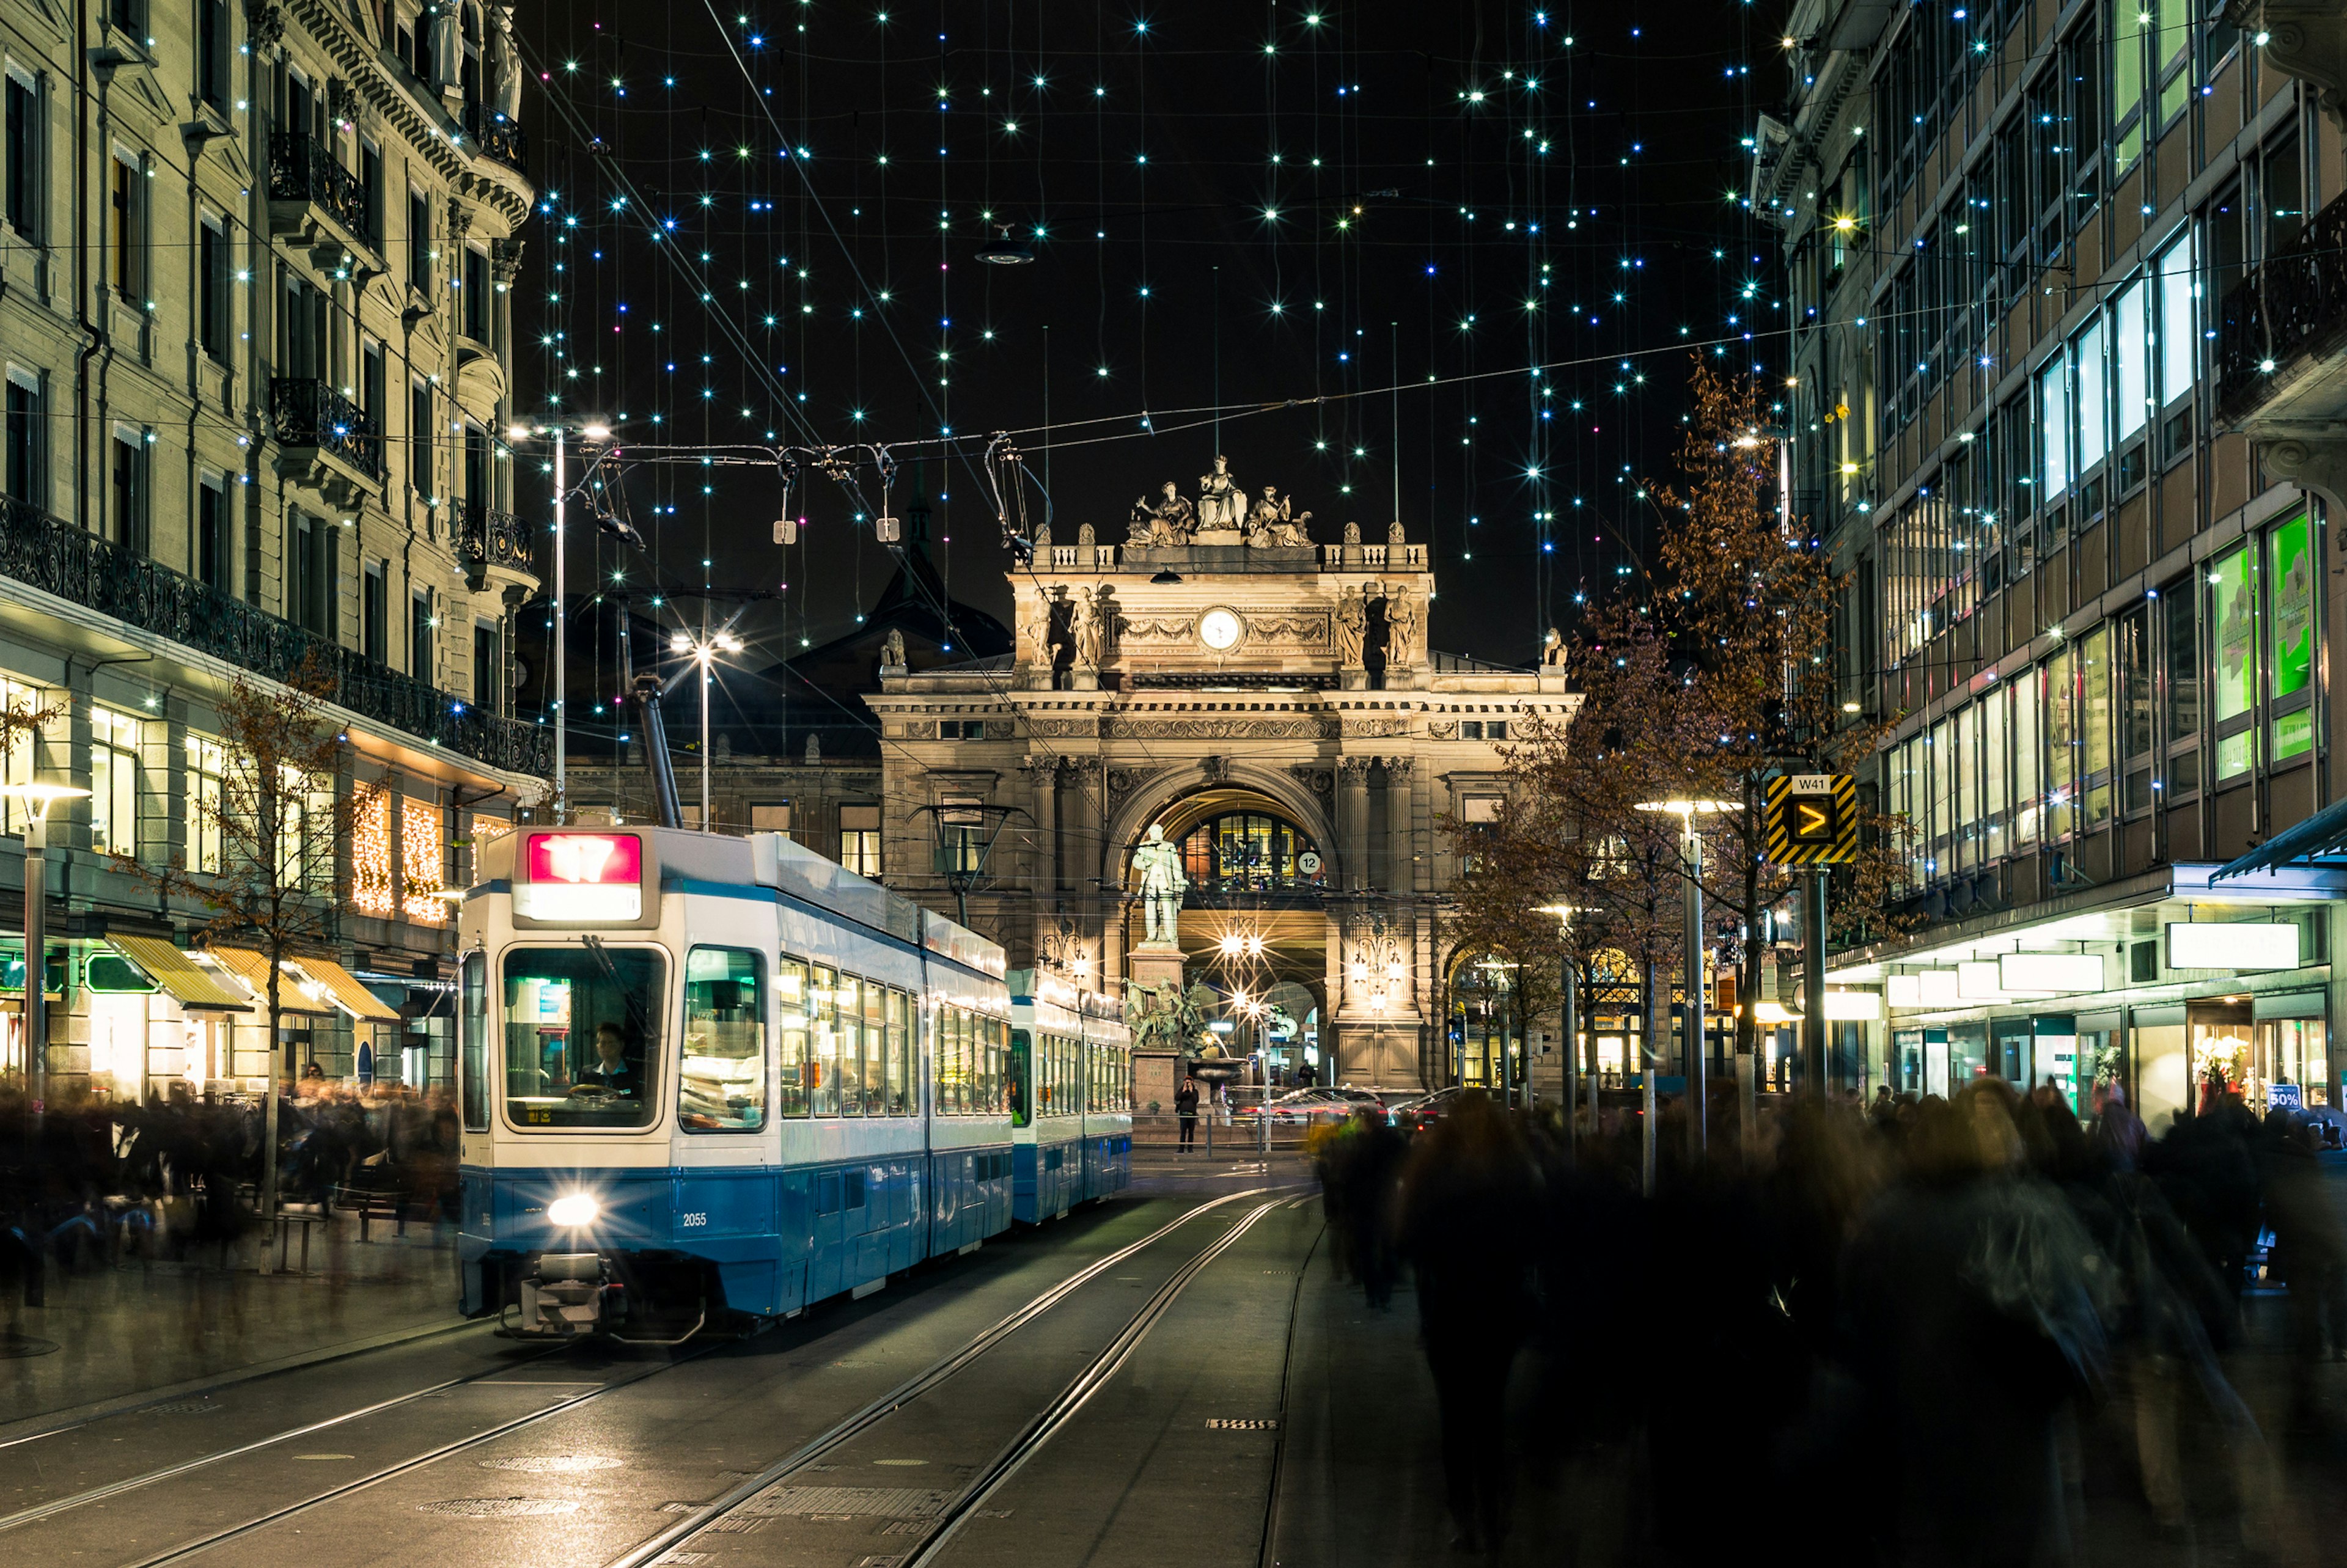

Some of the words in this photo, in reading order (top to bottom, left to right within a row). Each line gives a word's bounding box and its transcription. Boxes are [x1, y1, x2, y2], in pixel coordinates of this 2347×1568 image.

[1799, 779, 1823, 789] W41
[1303, 858, 1315, 868] 12
[2269, 1093, 2299, 1105] 50%
[683, 1212, 707, 1227] 2055
